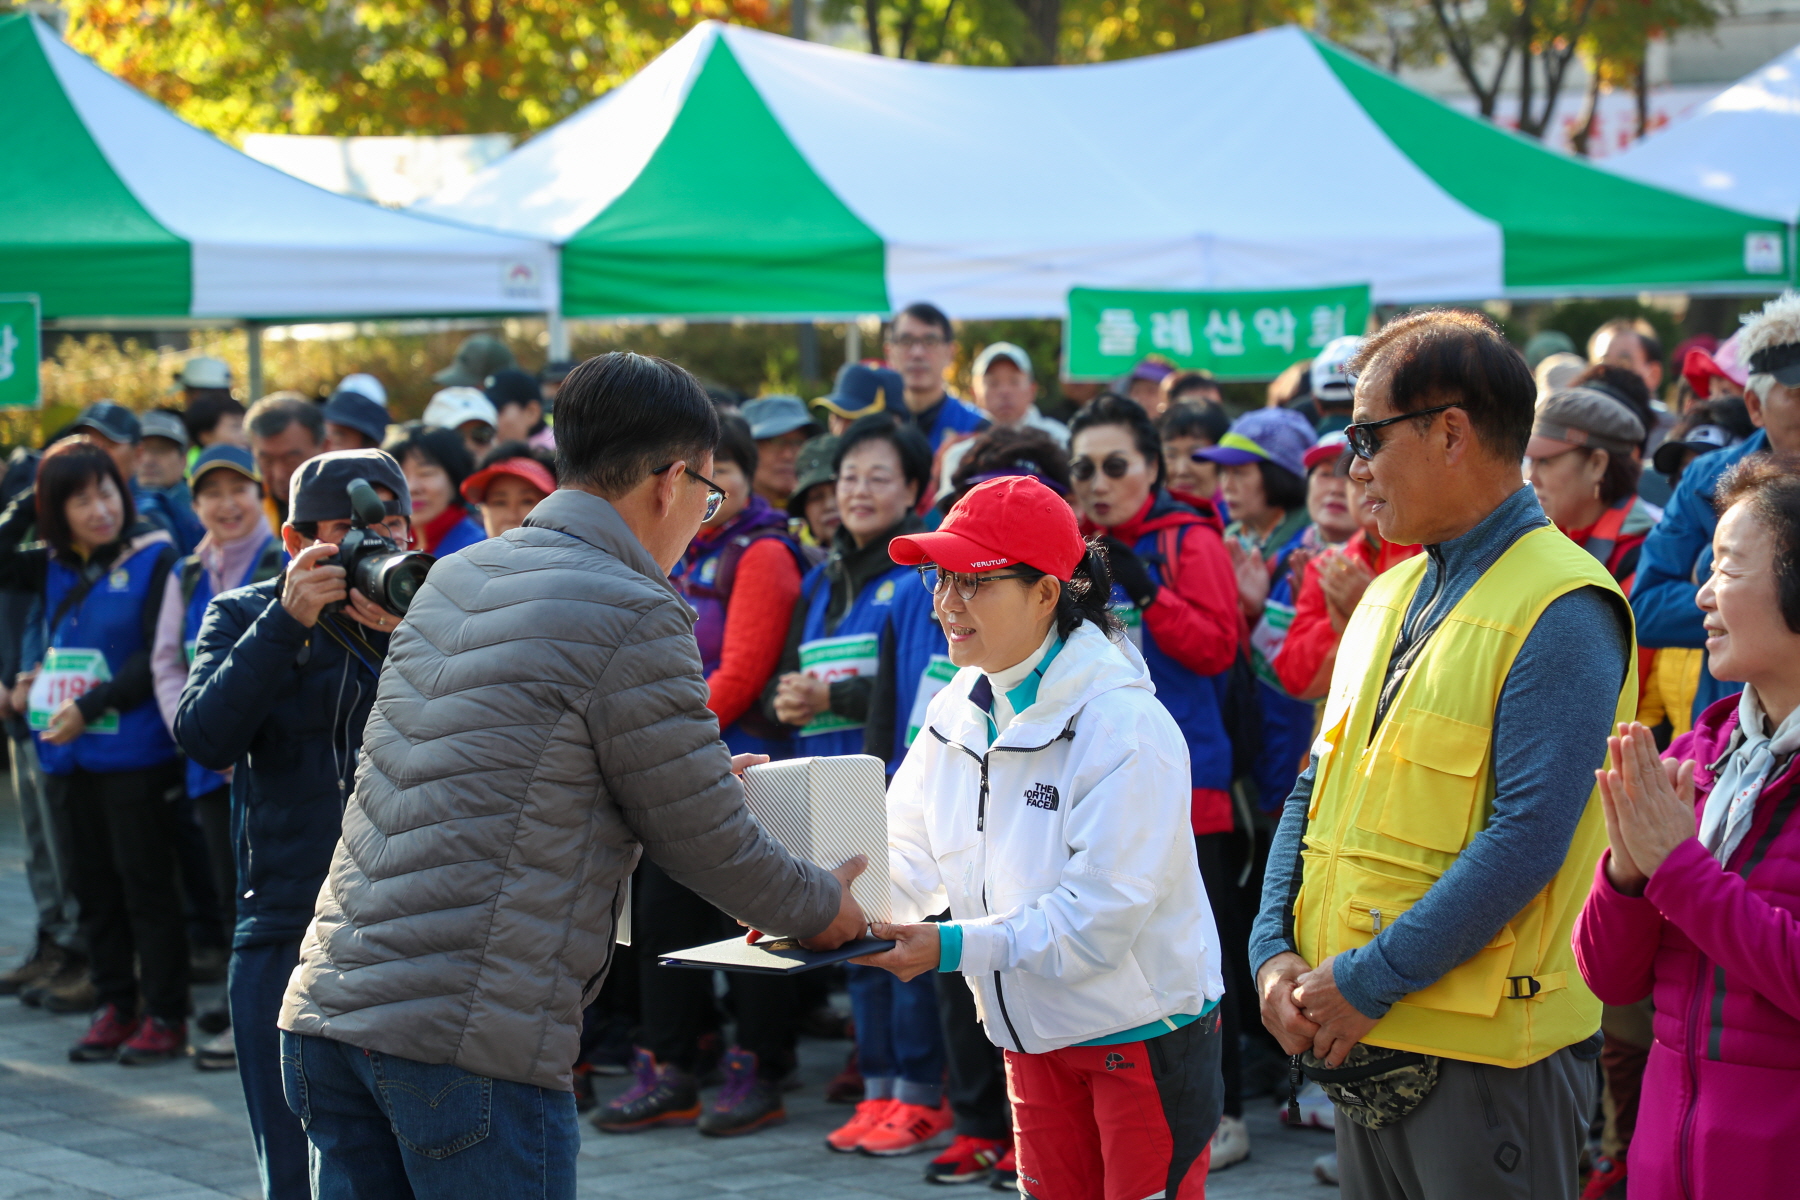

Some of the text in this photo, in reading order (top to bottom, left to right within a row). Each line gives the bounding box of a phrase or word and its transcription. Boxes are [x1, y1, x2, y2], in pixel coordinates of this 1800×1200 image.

[363, 538, 382, 546] Nikon
[970, 558, 1008, 568] VERUTUM
[1035, 782, 1053, 793] THE
[1026, 799, 1051, 810] FACE
